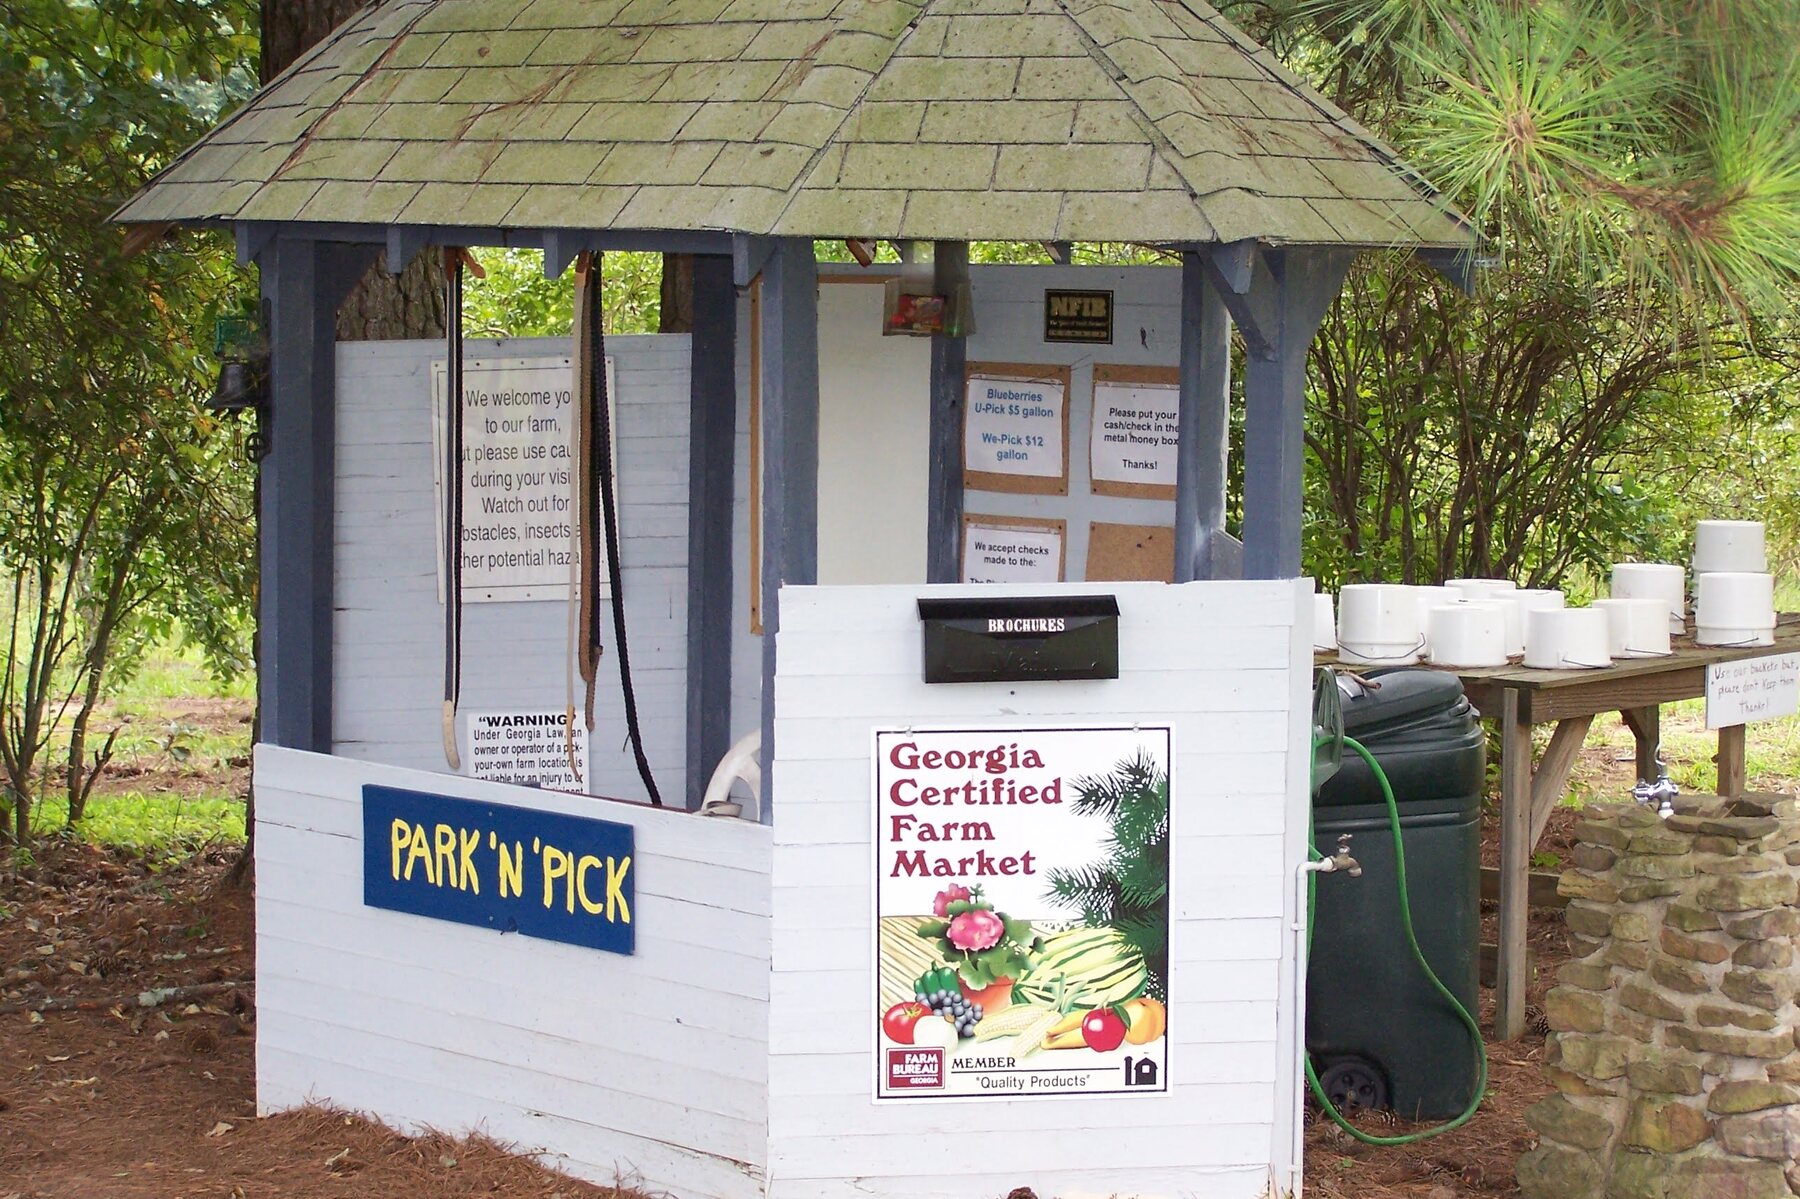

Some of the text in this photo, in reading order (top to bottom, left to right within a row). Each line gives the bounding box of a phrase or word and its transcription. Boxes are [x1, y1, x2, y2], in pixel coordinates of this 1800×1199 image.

[466, 389, 572, 408] We welcome yo
[987, 388, 1042, 402] Blueberries
[974, 403, 1054, 419] U-Pick $5 gallon
[1109, 408, 1176, 421] Please put your
[486, 415, 561, 434] to our farm,
[1104, 421, 1152, 432] cash/check
[1154, 422, 1162, 432] in
[982, 432, 1044, 447] We-Pick $12
[1104, 434, 1128, 442] metal
[1130, 436, 1158, 446] money
[475, 444, 518, 468] please
[523, 445, 546, 459] use
[996, 449, 1028, 461] gallon
[1122, 459, 1158, 470] Thanks!
[471, 467, 570, 491] during your visi
[481, 495, 570, 514] Watch out for
[463, 523, 520, 542] bstacles,
[974, 541, 1049, 556] We accept checks
[488, 549, 544, 571] potential
[984, 556, 1036, 567] made to the:
[988, 618, 1065, 632] BROCHURES
[474, 728, 582, 742] Under Georgia Law, an
[474, 745, 498, 756] owner
[501, 745, 509, 754] or
[512, 743, 544, 757] operator
[547, 742, 554, 753] of
[556, 744, 561, 753] a
[474, 759, 513, 772] your-own
[516, 757, 535, 768] farm
[576, 756, 582, 768] is
[890, 742, 1045, 774] Georgia
[514, 772, 525, 783] for
[540, 772, 562, 786] injury
[564, 772, 572, 783] to
[890, 777, 1063, 806] Certified
[890, 814, 996, 842] Farm
[391, 818, 480, 896] PARK
[890, 849, 1036, 878] Market
[905, 1053, 938, 1064] FARM
[952, 1056, 1016, 1069] MEMBER
[892, 1064, 938, 1075] BUREAU
[976, 1074, 1091, 1090] "Quality Products"
